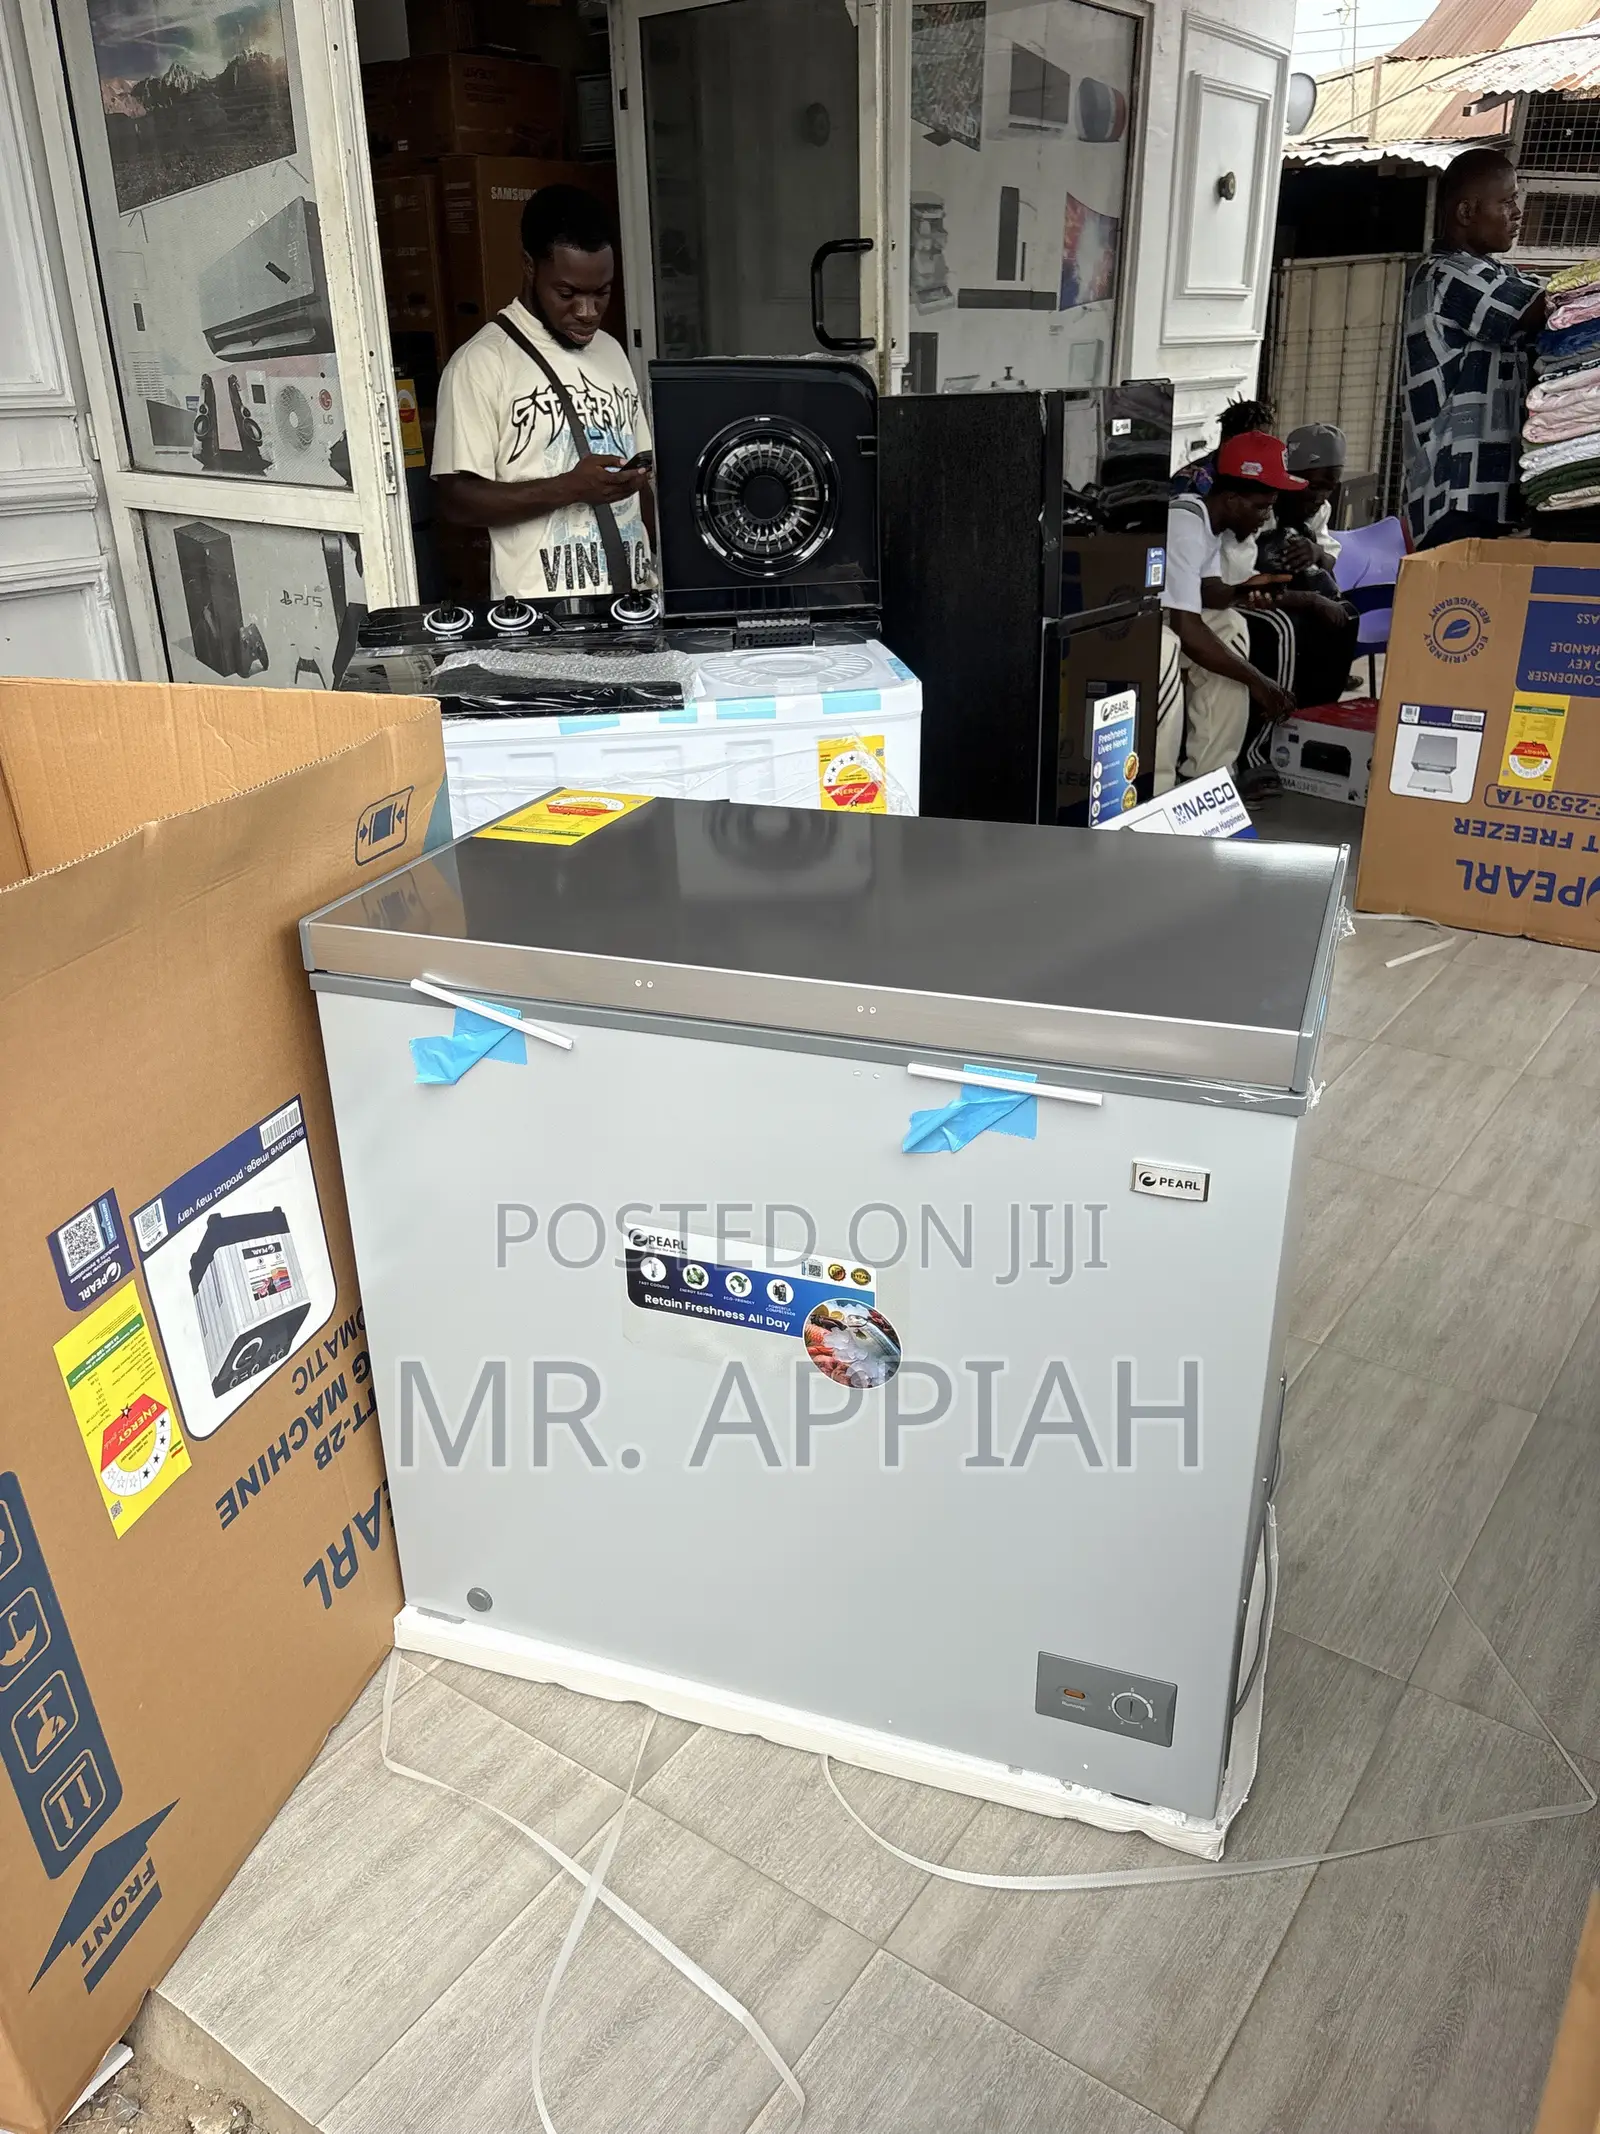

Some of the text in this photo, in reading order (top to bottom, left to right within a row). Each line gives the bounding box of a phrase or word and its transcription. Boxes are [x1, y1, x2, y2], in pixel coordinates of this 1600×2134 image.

[490, 186, 538, 202] SAMSUN
[293, 593, 323, 608] PS5
[1568, 658, 1591, 670] KEY
[1110, 701, 1130, 716] PEARL
[1182, 782, 1236, 821] NASCO
[1220, 812, 1247, 831] Happiness
[1453, 817, 1574, 849] FREEZER
[1456, 859, 1587, 908] PEARL
[243, 1149, 270, 1177] image,
[213, 1168, 243, 1196] product
[1159, 1177, 1201, 1191] PEARL
[194, 1188, 213, 1212] may
[175, 1203, 194, 1225] vary
[648, 1235, 688, 1251] PEARL
[77, 1275, 105, 1302] PEARL
[644, 1294, 790, 1332] Retain Freshness All Day
[291, 1304, 366, 1396] OMATIC
[115, 1400, 158, 1446] ENERGY
[216, 1372, 349, 1531] MACHINE
[81, 1856, 156, 1968] FRONT
